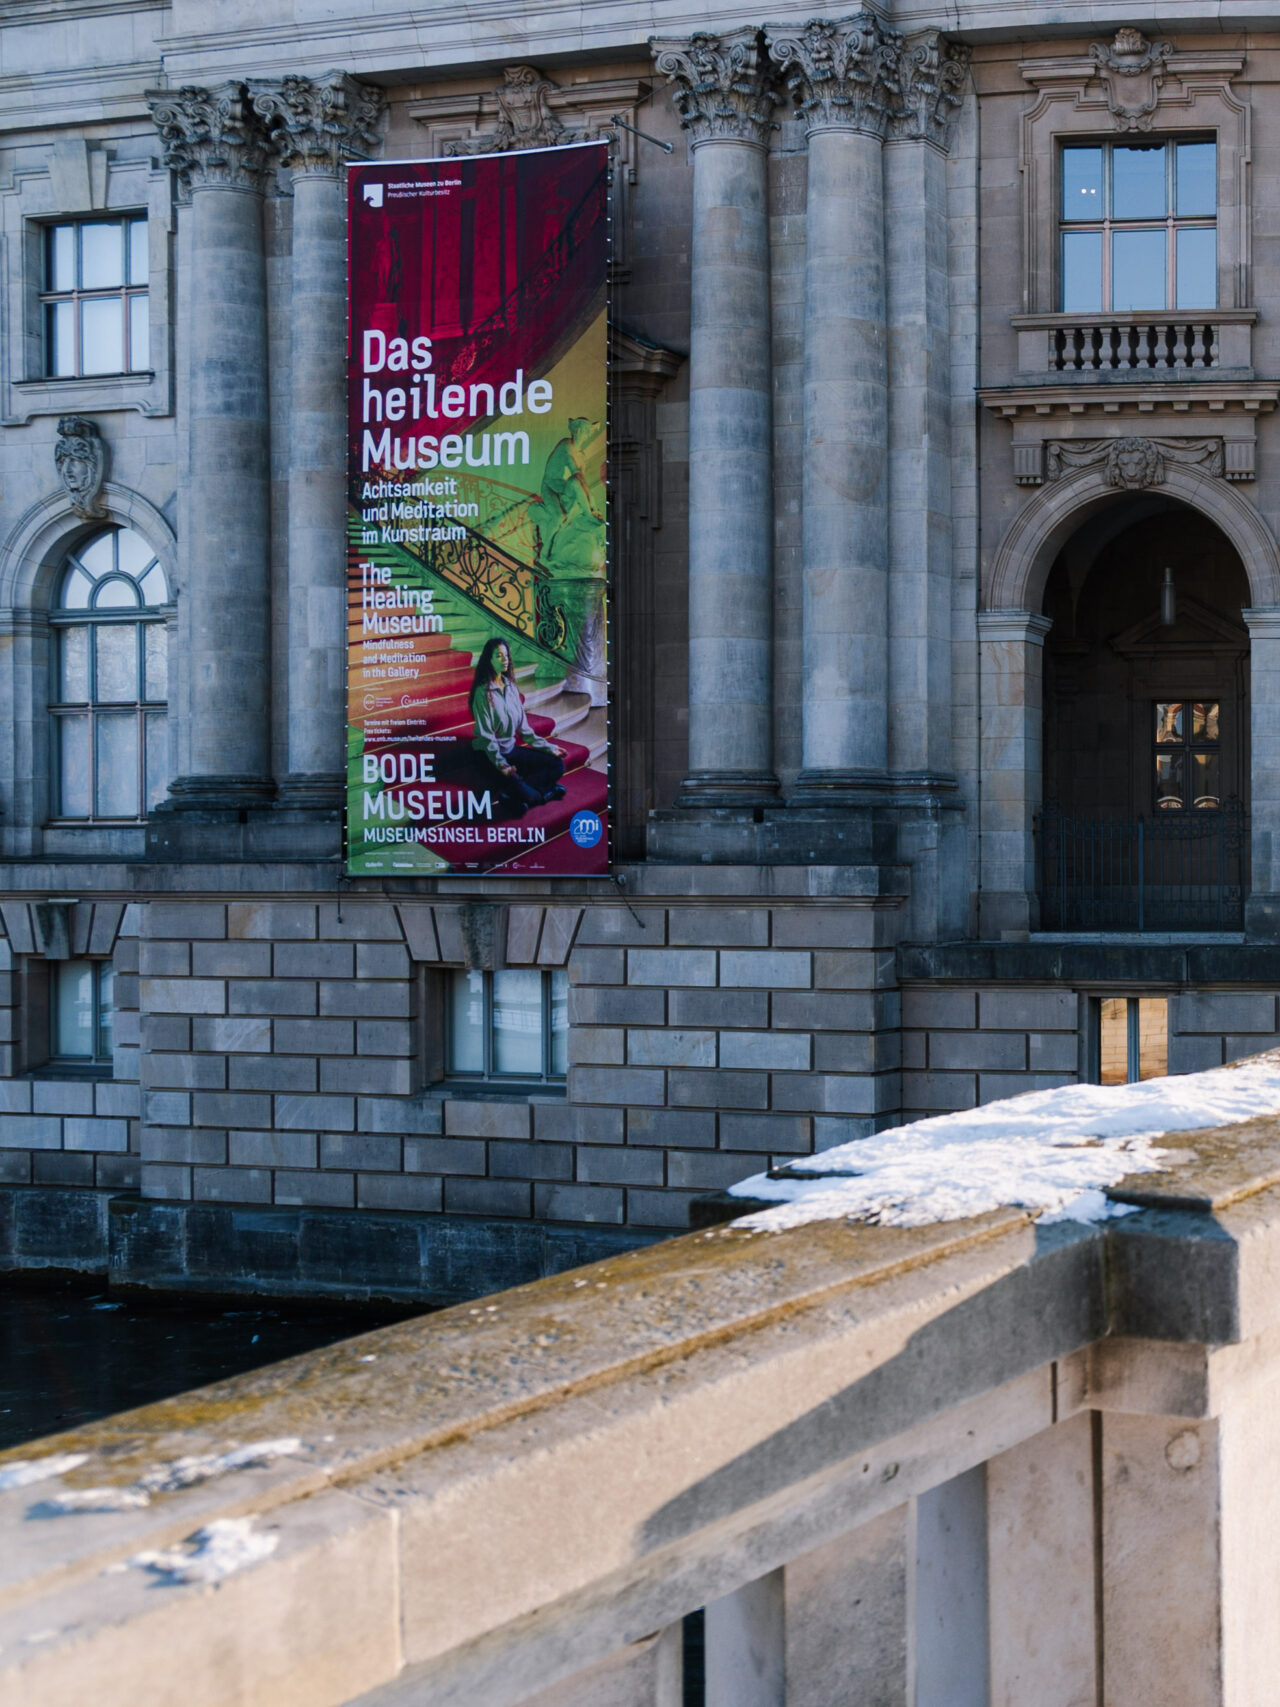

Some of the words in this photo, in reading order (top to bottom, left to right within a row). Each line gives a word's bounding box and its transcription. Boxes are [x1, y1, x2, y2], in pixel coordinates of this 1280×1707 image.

[363, 329, 433, 373] Das
[362, 368, 553, 423] heilende
[362, 427, 530, 472] Museum
[362, 476, 457, 500] Achtsamkeit
[362, 502, 389, 522] und
[391, 498, 479, 520] Meditation
[362, 526, 378, 544] im
[381, 524, 467, 543] Kunstraum
[358, 561, 392, 586] The
[362, 583, 434, 614] Healing
[362, 611, 444, 635] Museum
[362, 639, 415, 650] Mindfulness
[362, 653, 378, 665] and
[380, 652, 427, 664] Meditation
[362, 667, 371, 678] in
[372, 667, 386, 678] the
[387, 666, 420, 680] Gallery
[362, 753, 436, 783] BODE
[362, 790, 492, 820] MUSEUM
[363, 827, 484, 843] MUSEUMSINSEL
[487, 827, 546, 843] BERLIN
